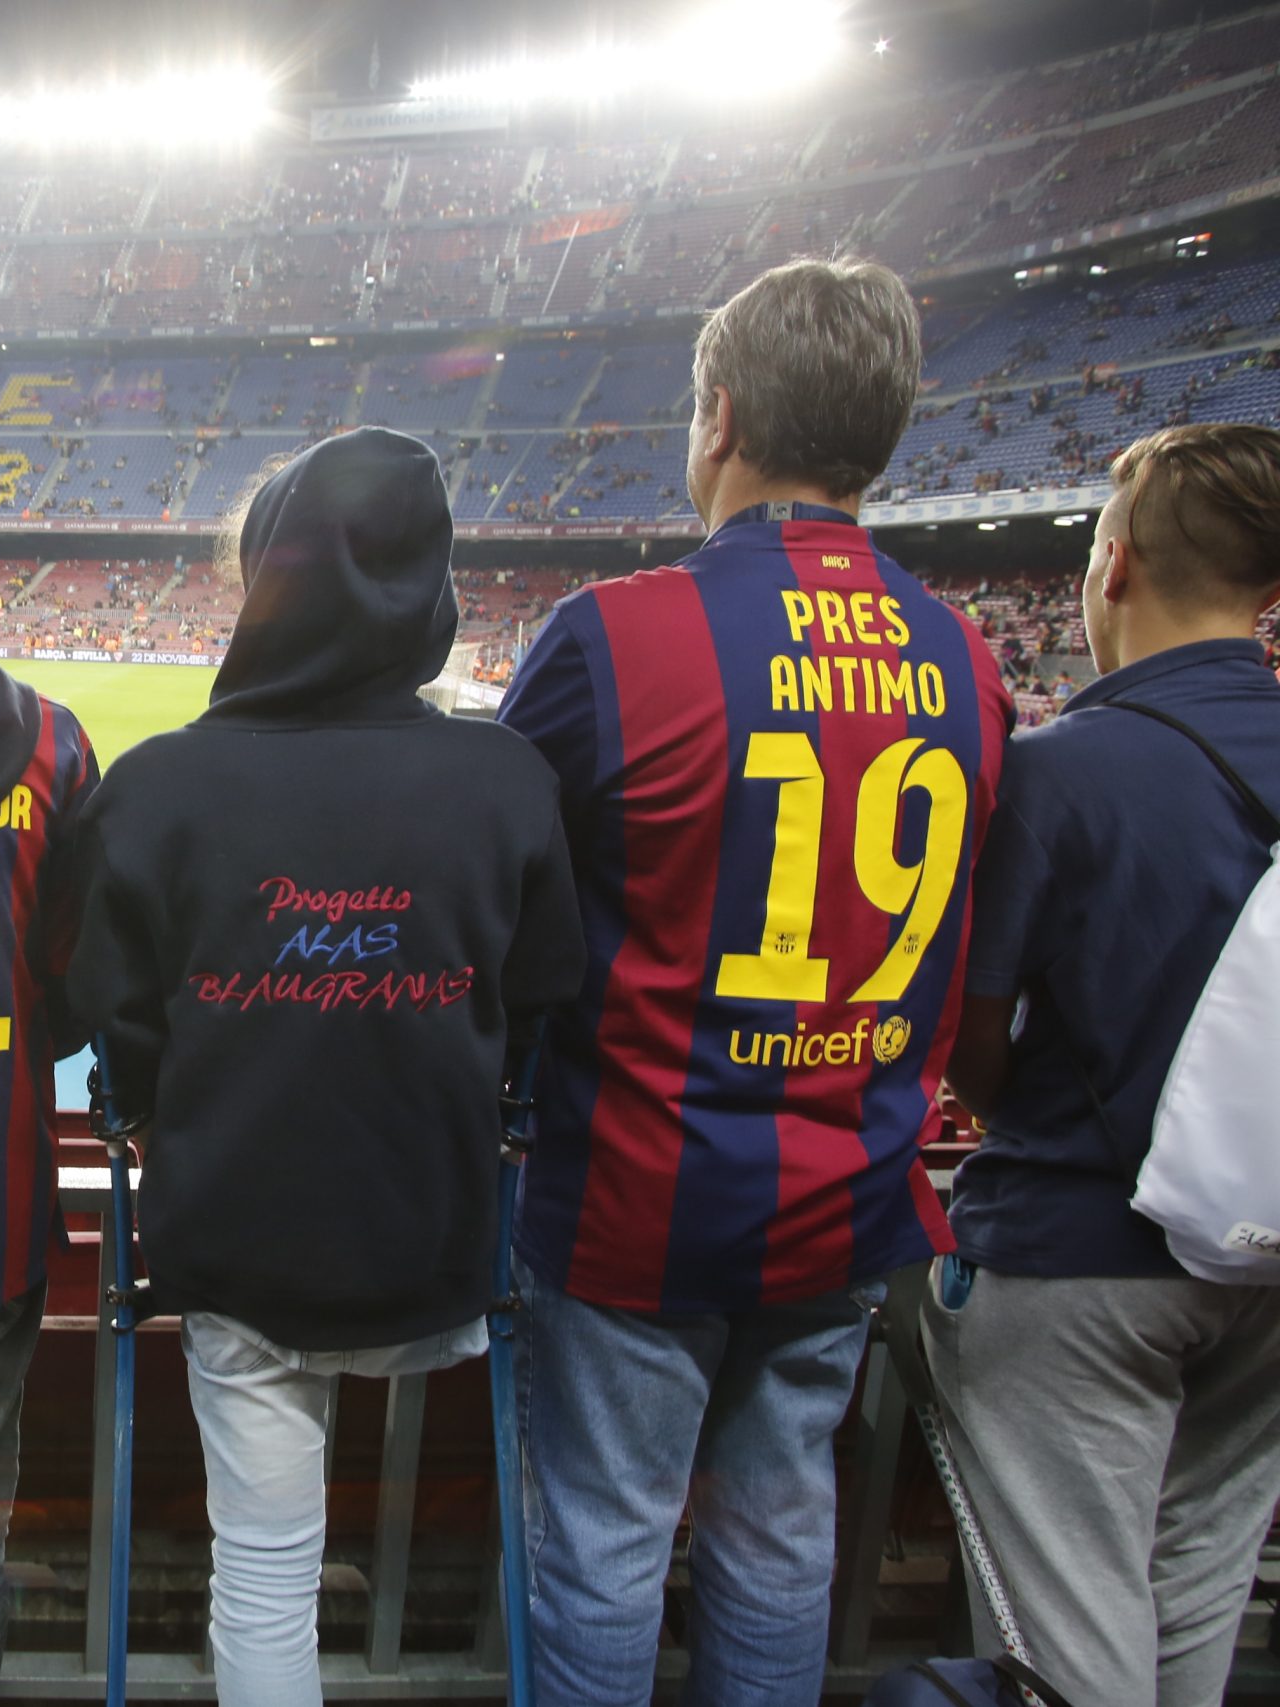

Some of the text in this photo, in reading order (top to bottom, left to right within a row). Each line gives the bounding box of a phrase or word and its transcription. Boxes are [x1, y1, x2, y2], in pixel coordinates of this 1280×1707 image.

[821, 554, 851, 571] BARÇA
[780, 588, 910, 647] PRES
[34, 649, 111, 662] BARÇA SEVILLA
[770, 654, 946, 717] ANTIMO
[715, 731, 968, 1003] 19
[259, 876, 412, 922] Progetto
[274, 923, 399, 966] ALAS
[188, 965, 475, 1012] BLAUGRANAS
[728, 1017, 870, 1067] unicef
